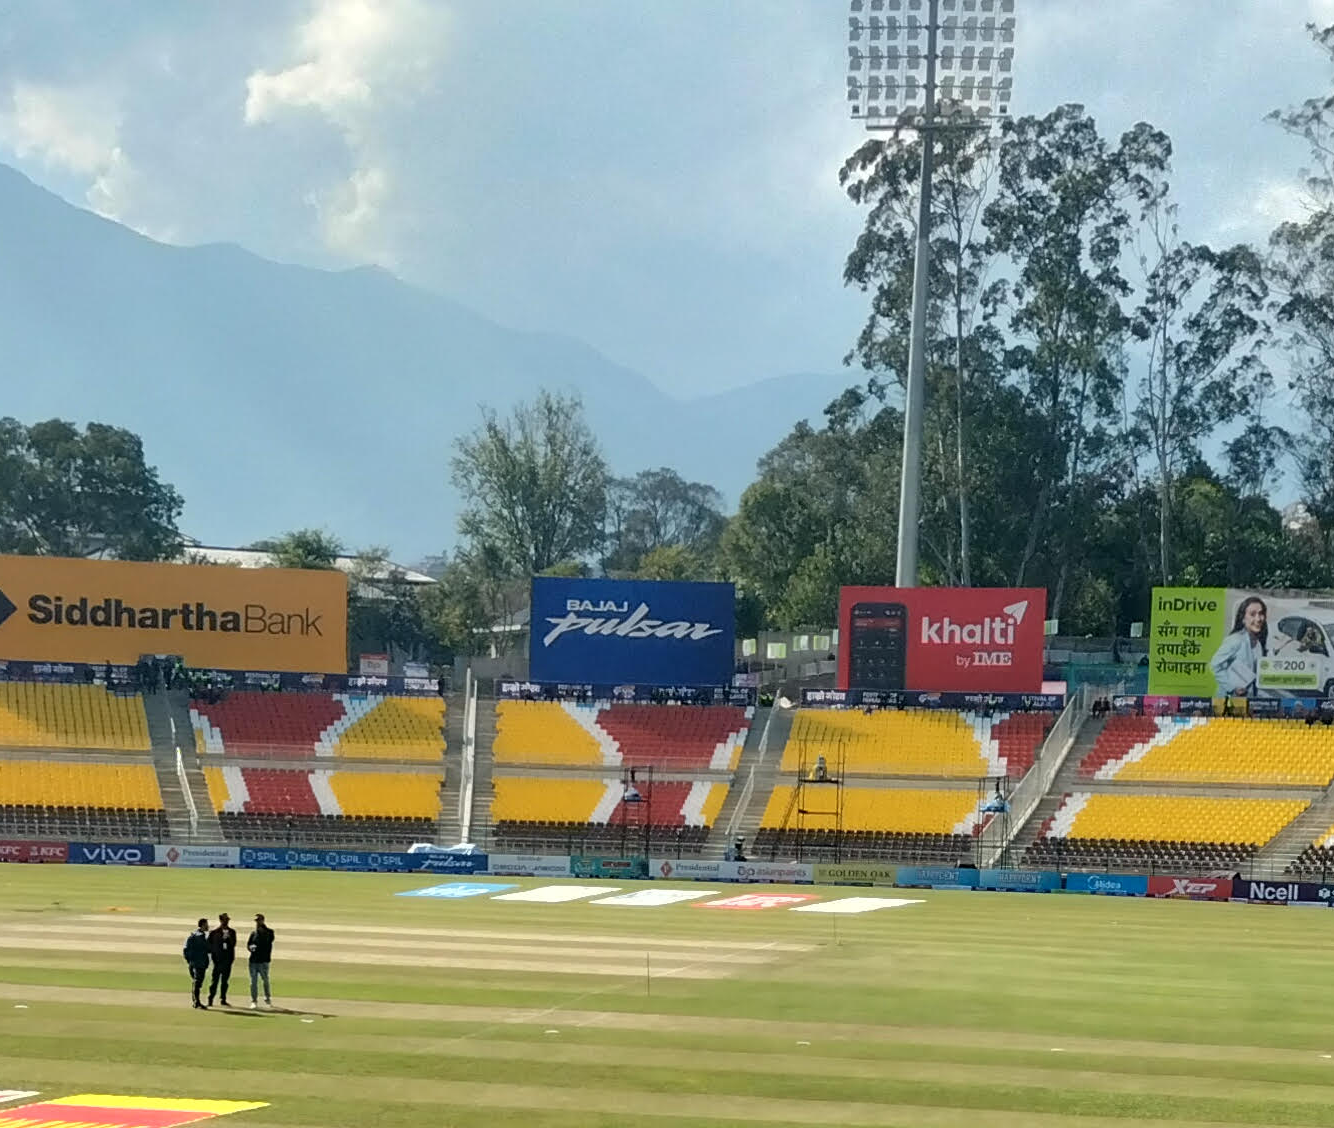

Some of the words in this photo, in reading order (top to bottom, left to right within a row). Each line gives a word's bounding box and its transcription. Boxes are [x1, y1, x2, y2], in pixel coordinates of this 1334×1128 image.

[567, 599, 628, 612] BAJAJ
[1158, 596, 1217, 612] inDrive
[543, 602, 723, 647] pulsar
[921, 615, 1015, 645] khalti
[1182, 625, 1211, 638] यात्रा
[956, 654, 971, 668] by
[972, 652, 1012, 666] IME
[38, 847, 65, 856] KFC
[82, 844, 142, 861] vivo
[257, 851, 278, 861] SPIL
[300, 852, 320, 863] SPIL
[340, 854, 361, 865] SPIL
[382, 856, 404, 866] SPIL
[828, 869, 868, 878] GOLDEN
[869, 870, 891, 879] OAK
[1250, 882, 1299, 900] Ncell
